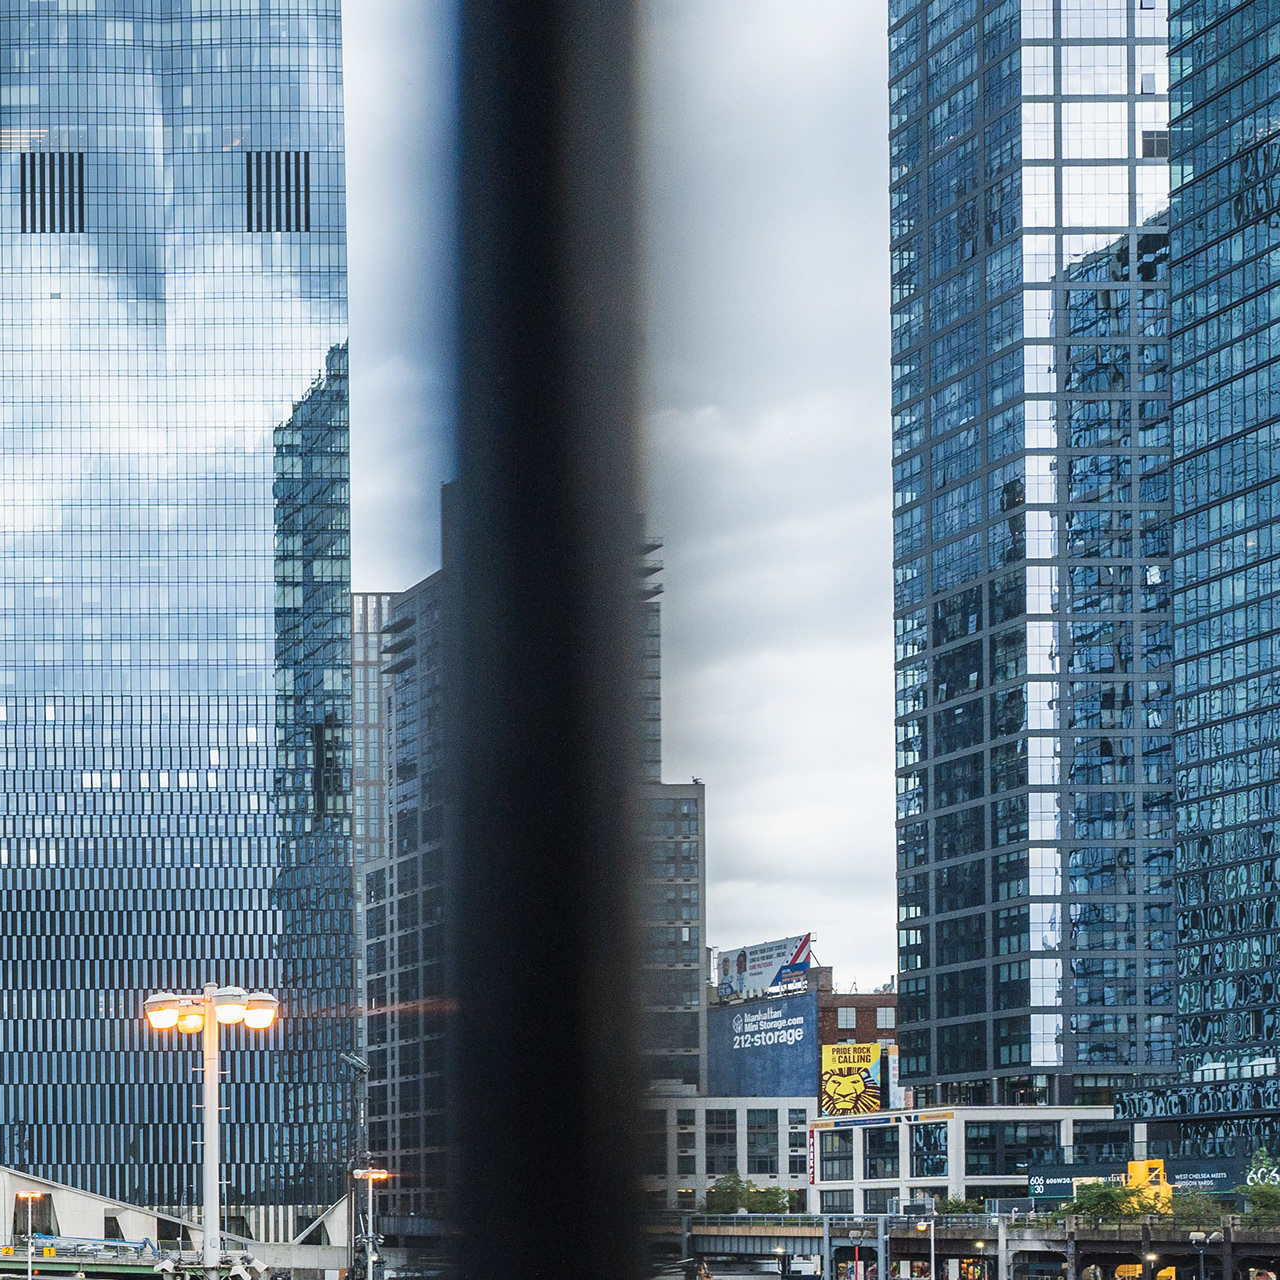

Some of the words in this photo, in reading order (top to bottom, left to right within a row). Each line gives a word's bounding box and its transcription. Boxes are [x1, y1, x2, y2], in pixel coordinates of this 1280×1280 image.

[745, 1007, 782, 1022] Manhattan
[745, 1022, 758, 1032] Mini
[759, 1017, 804, 1031] Storage.com
[831, 1047, 851, 1055] PRIDE
[838, 1055, 871, 1064] CALLING
[1030, 1176, 1044, 1185] 606
[1035, 1185, 1044, 1193] 30
